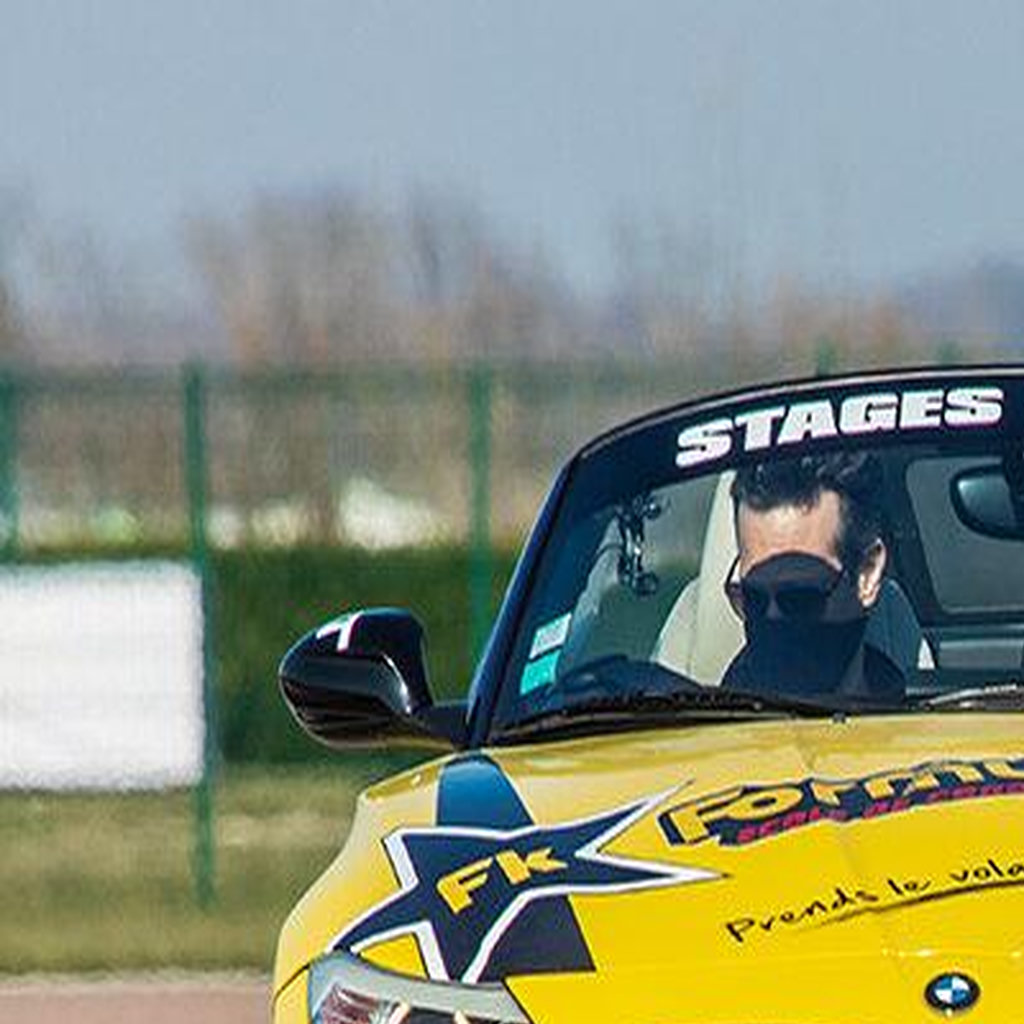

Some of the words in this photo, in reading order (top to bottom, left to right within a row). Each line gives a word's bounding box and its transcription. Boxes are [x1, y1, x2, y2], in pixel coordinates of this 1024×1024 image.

[676, 386, 1003, 469] STAGES
[725, 887, 879, 943] Prends
[886, 878, 932, 897] le
